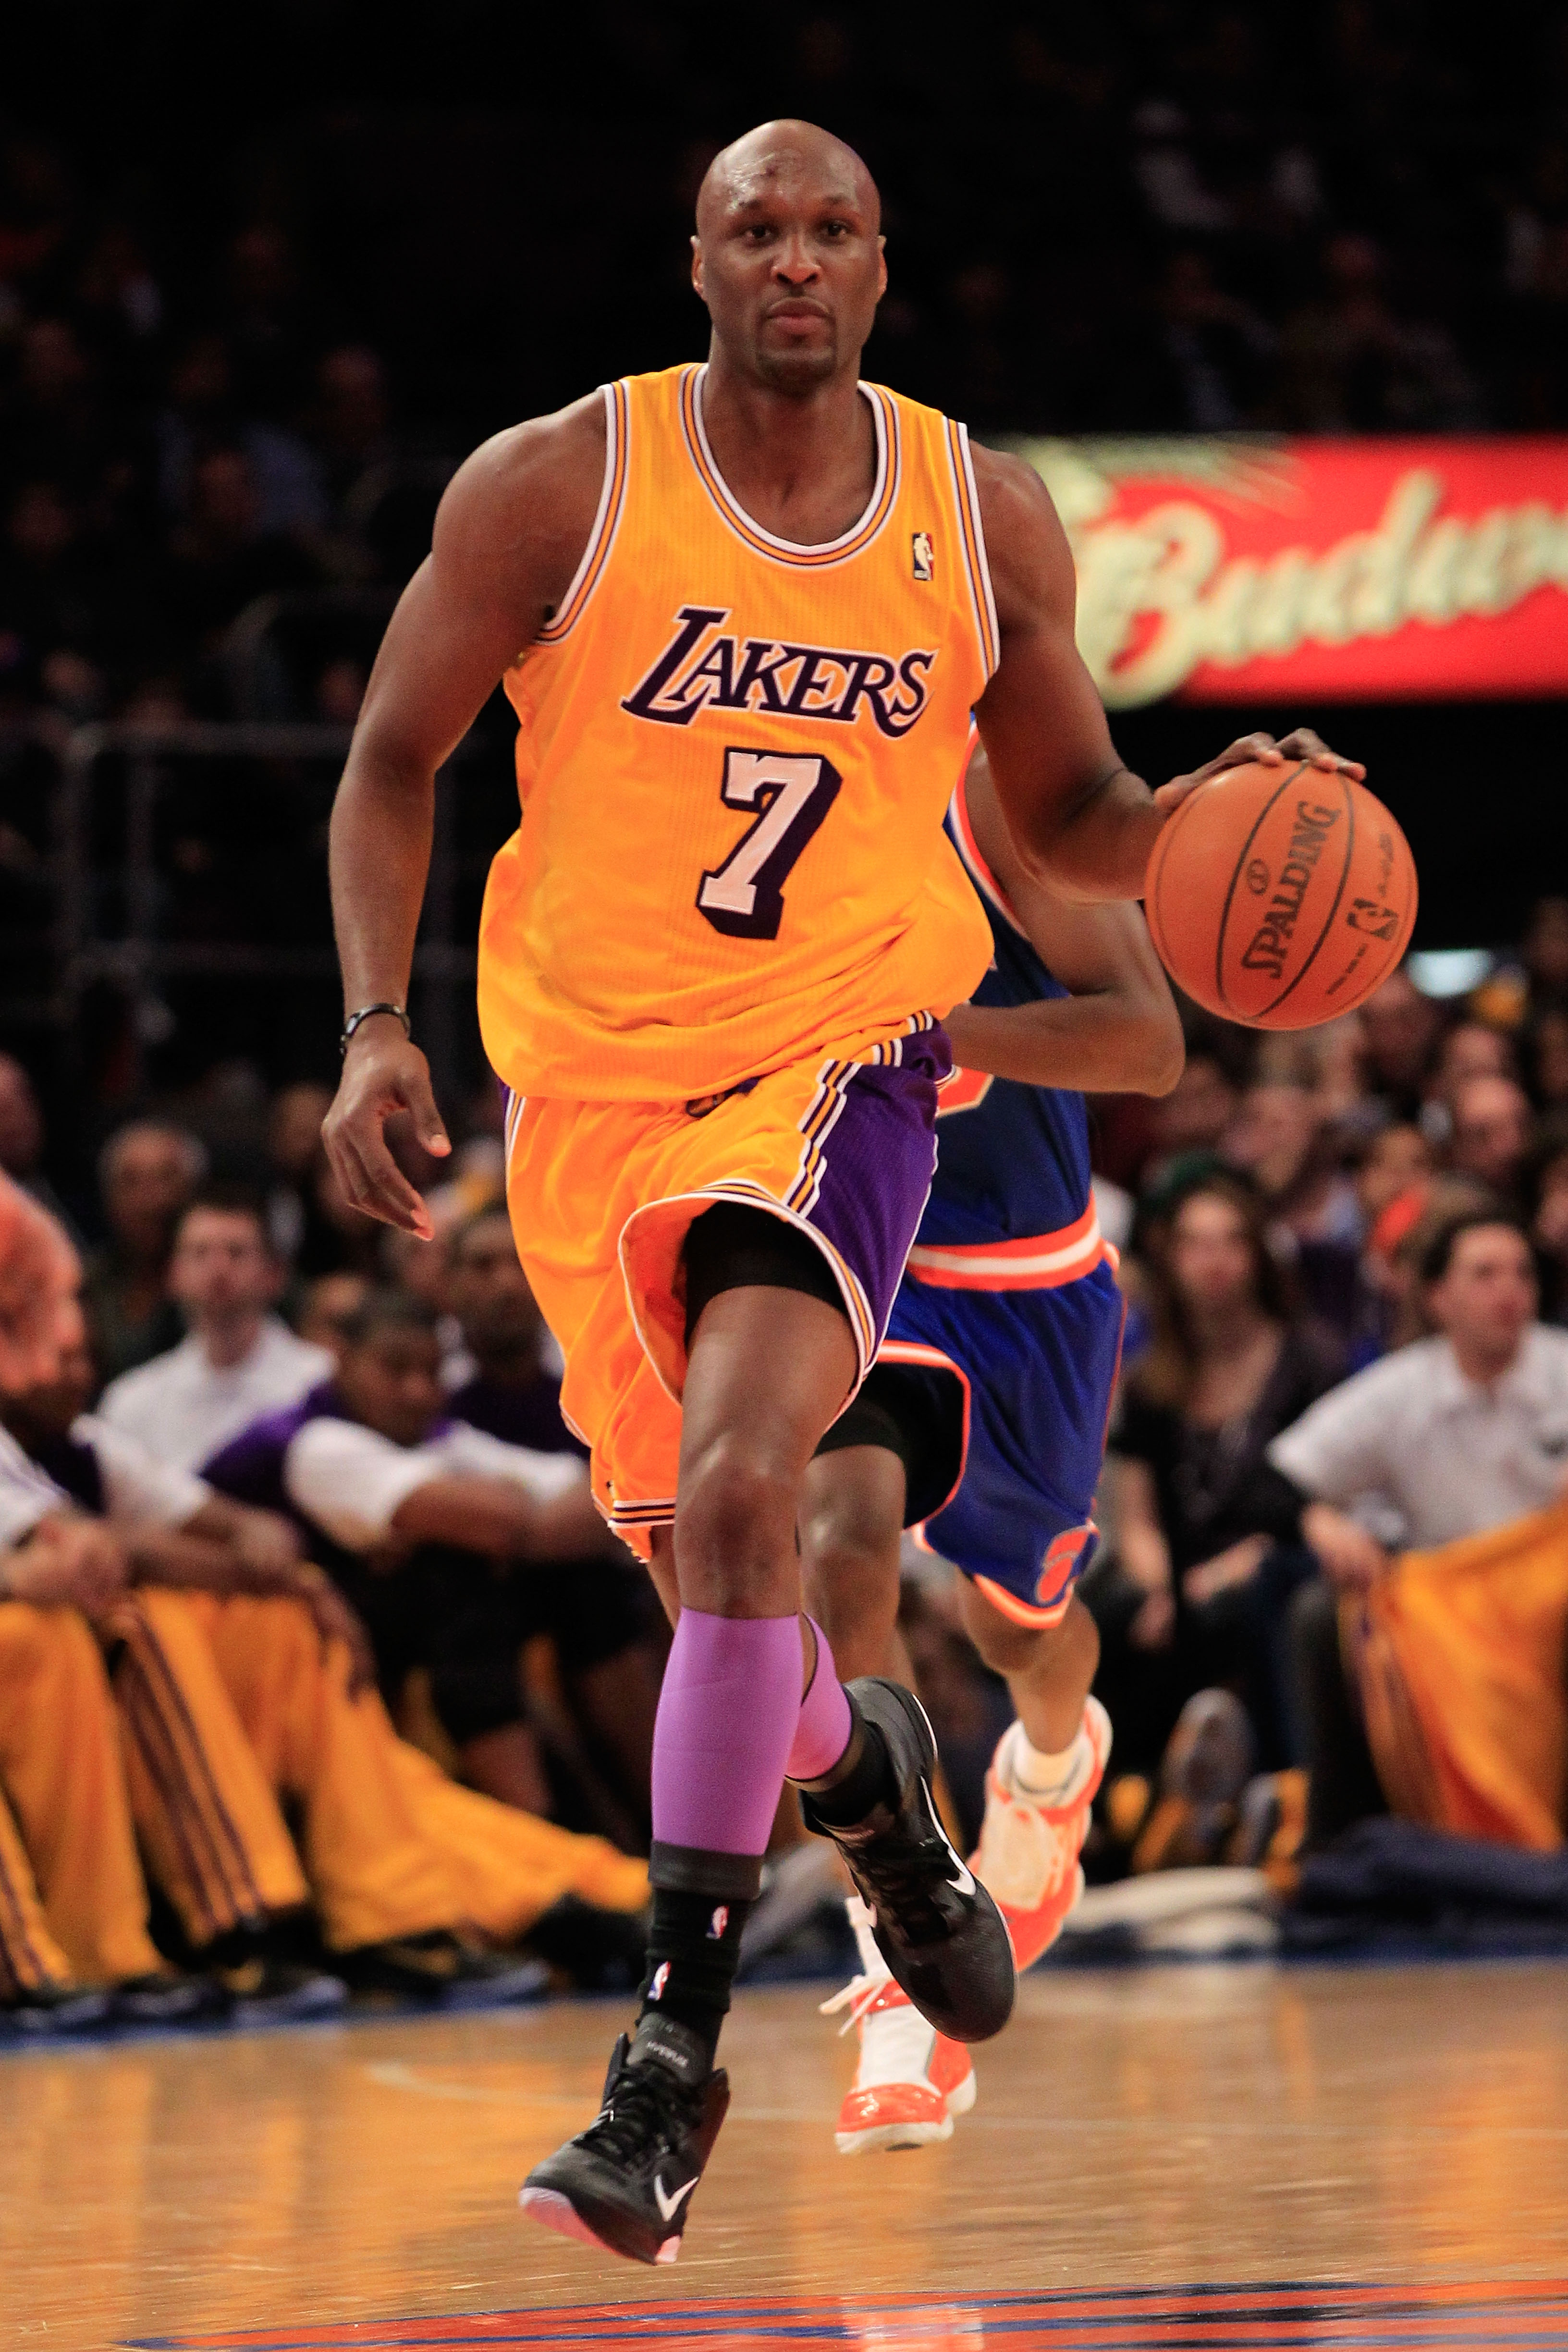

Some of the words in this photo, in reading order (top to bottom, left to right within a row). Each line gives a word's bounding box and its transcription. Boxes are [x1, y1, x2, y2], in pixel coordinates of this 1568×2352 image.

[620, 604, 940, 740] LAKERS
[1072, 467, 1568, 711] Budw
[695, 747, 843, 940] 7
[1241, 800, 1341, 980] SPALDING
